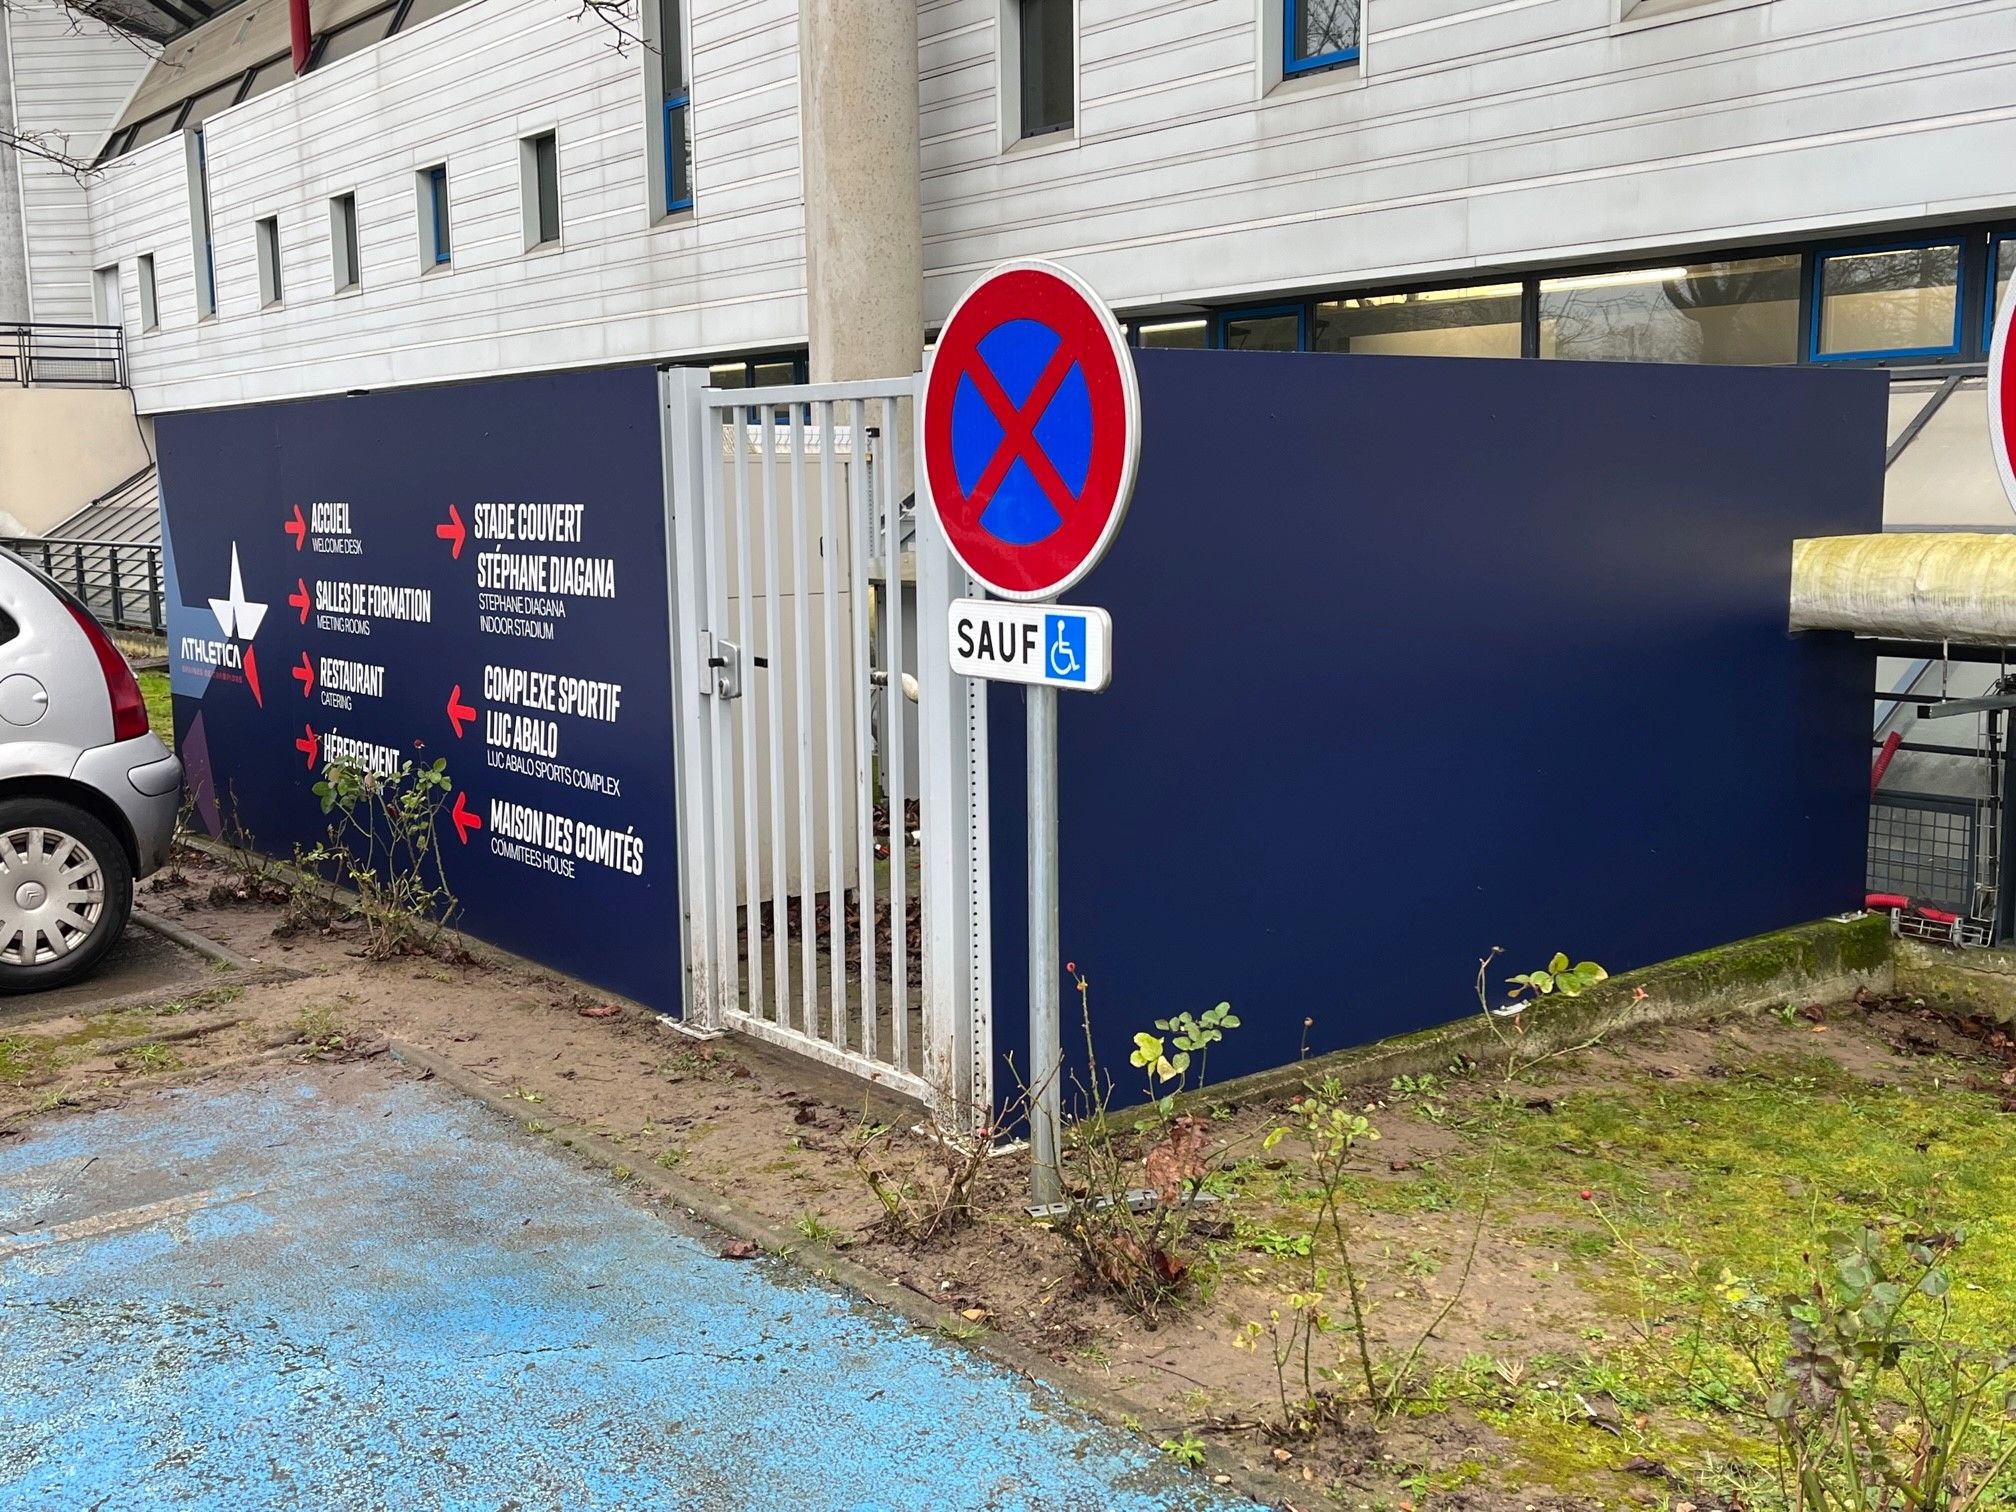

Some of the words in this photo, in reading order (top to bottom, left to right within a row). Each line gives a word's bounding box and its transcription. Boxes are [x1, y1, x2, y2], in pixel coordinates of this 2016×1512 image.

[311, 502, 352, 534] ACCUEIL
[474, 503, 516, 540] STADE
[518, 503, 584, 542] COUVERT
[312, 538, 344, 553] WELCOME
[344, 539, 363, 555] DESK
[477, 544, 547, 592] STÉPHANE
[549, 556, 615, 598] DIAGANA
[316, 580, 351, 614] SALLES
[352, 583, 366, 615] DE
[367, 585, 431, 623] FORMATION
[479, 593, 524, 613] STEPHANE
[525, 597, 566, 618] DIAGANA
[316, 615, 345, 632] MEETING
[345, 618, 370, 635] ROOMS
[480, 615, 514, 635] INDOOR
[514, 618, 554, 640] STADIUM
[957, 618, 1038, 664] SAUF
[181, 636, 242, 669] ATHLETICA
[320, 657, 385, 698] RESTAURANT
[484, 665, 556, 711] COMPLEXE
[558, 676, 622, 722] SPORTIF
[321, 690, 352, 711] CATERING
[486, 710, 512, 748] LUC
[512, 715, 558, 759] ABALO
[487, 749, 505, 769] LUC
[505, 754, 534, 776] ABALO
[535, 760, 572, 785] SPORTS
[572, 768, 621, 797] COMPLEX
[490, 798, 543, 846] MAISON
[545, 813, 573, 855] DES
[575, 825, 644, 876] COMITÉS
[491, 837, 542, 868] COMMITEES
[542, 851, 576, 879] HOUSE
